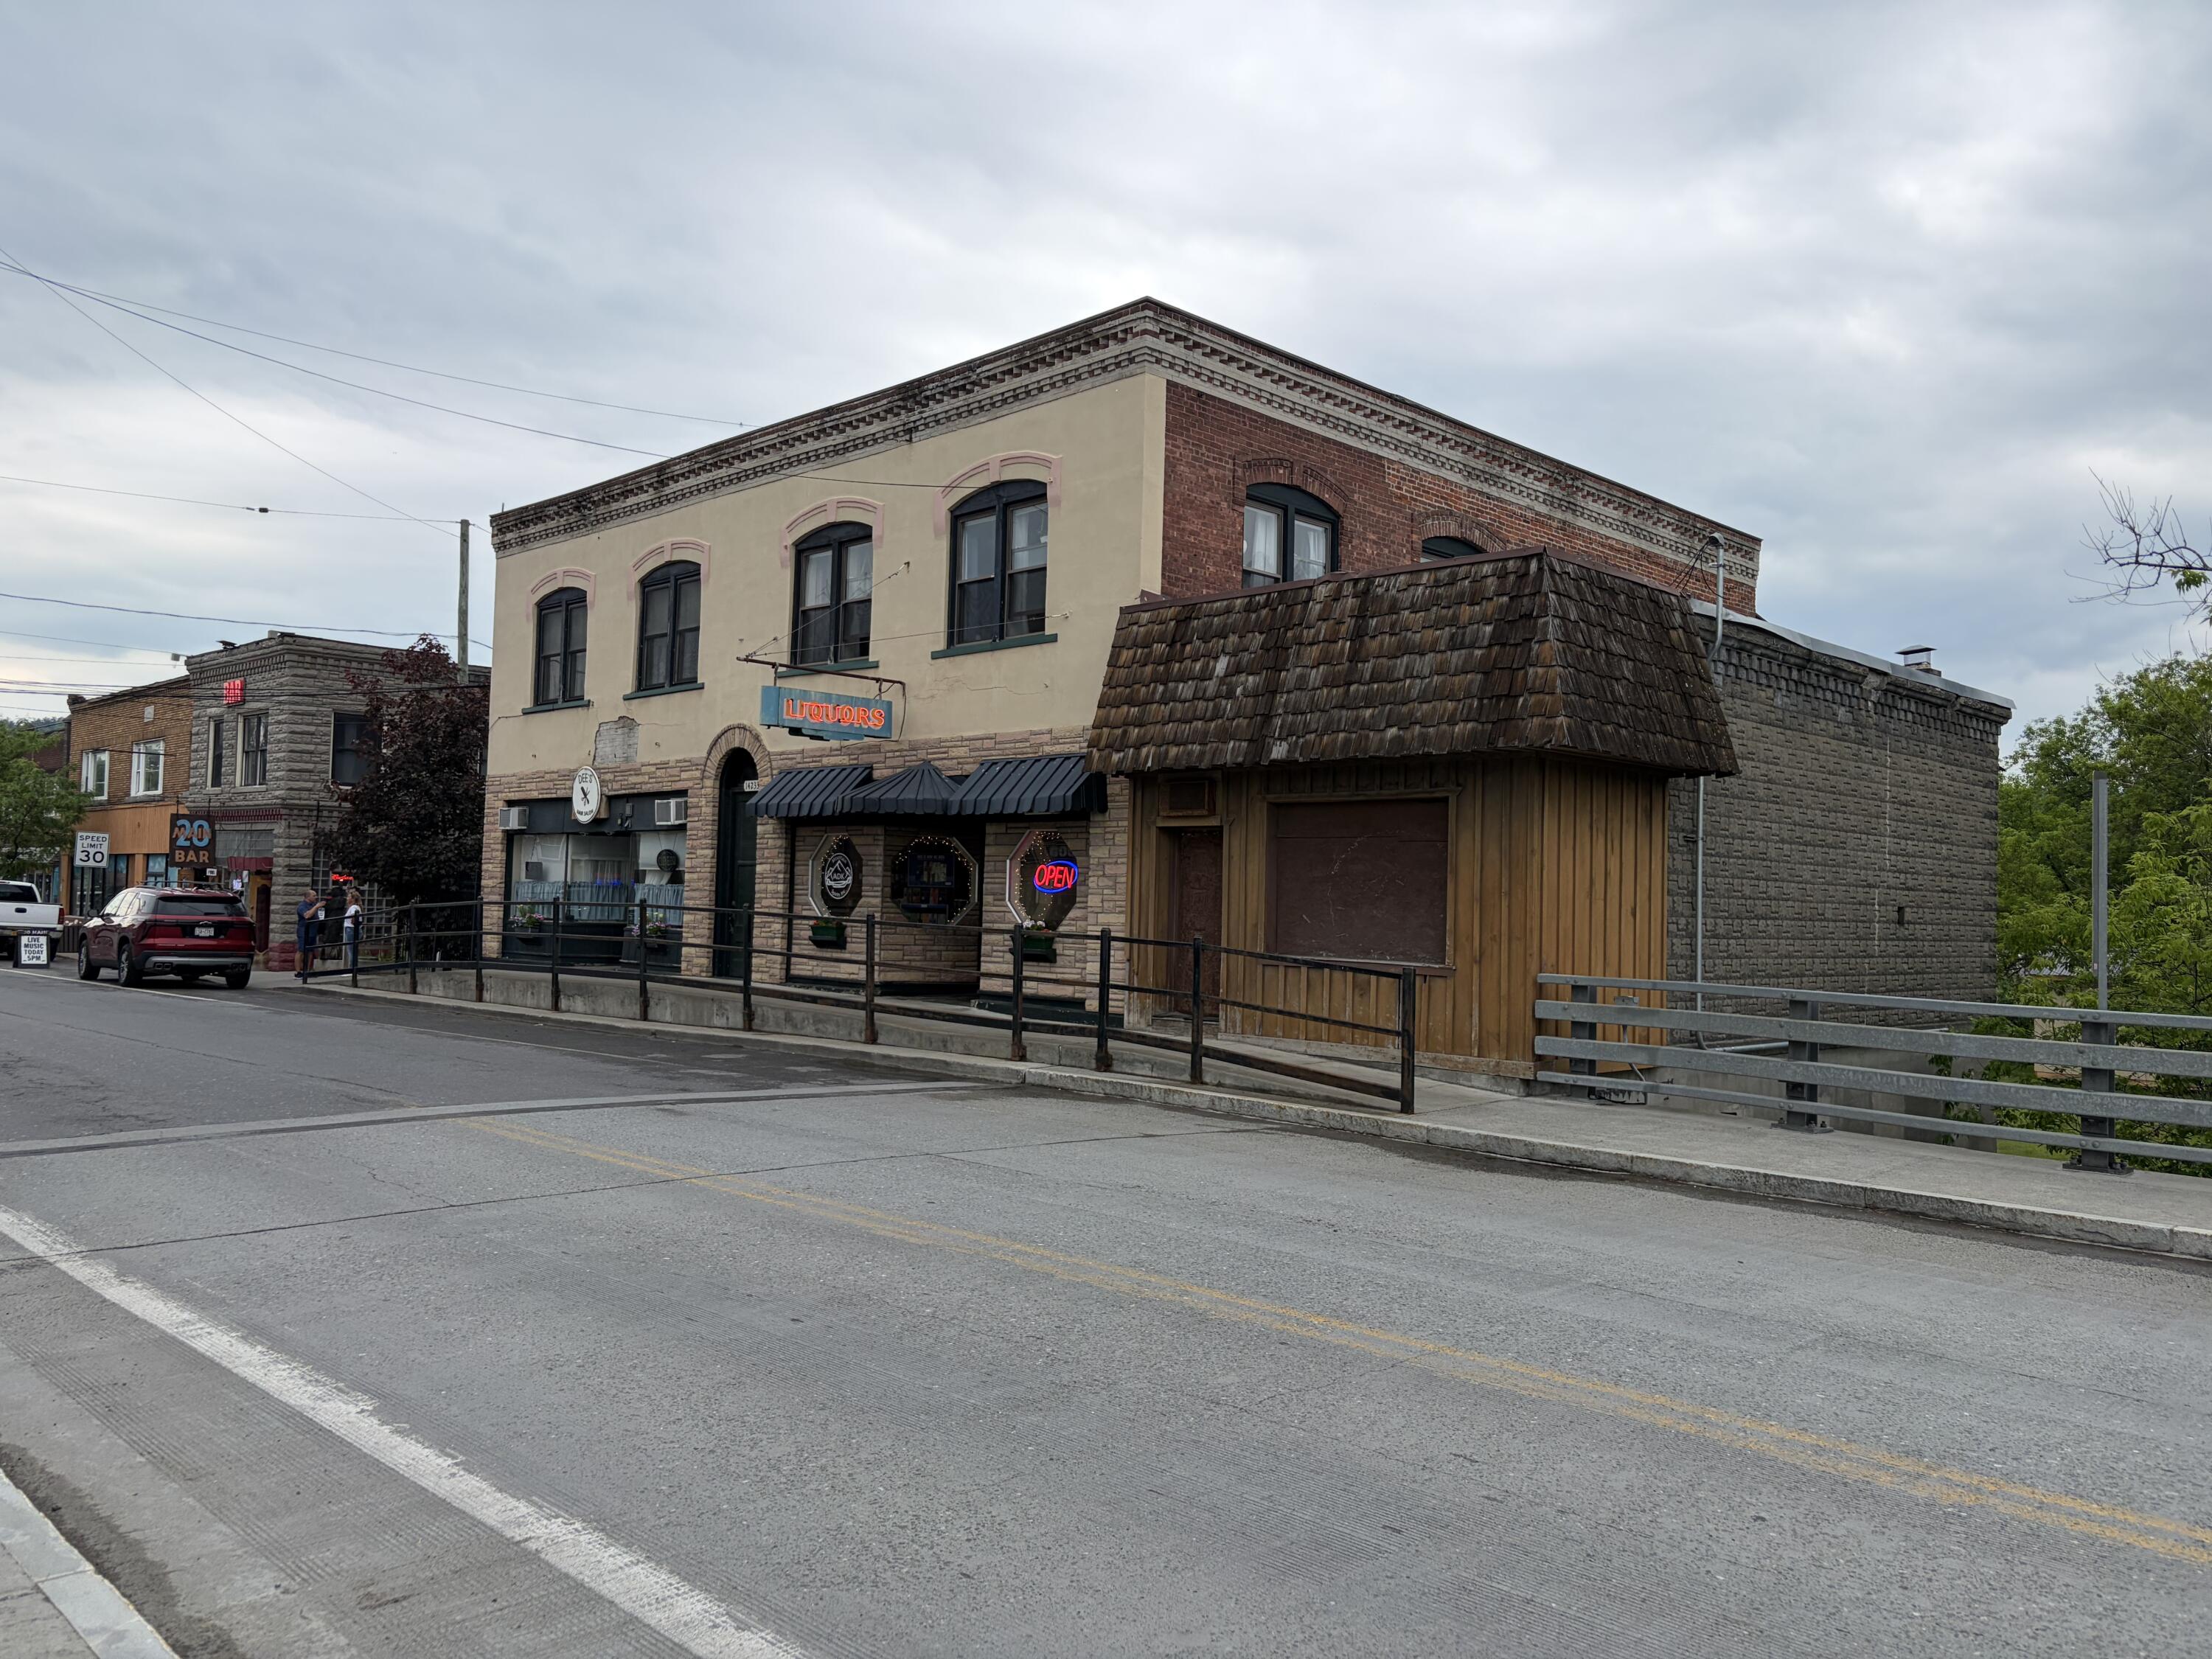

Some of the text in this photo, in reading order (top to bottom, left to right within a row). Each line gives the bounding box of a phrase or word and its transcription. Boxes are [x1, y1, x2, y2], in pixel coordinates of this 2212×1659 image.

[223, 680, 241, 704] BAR
[784, 698, 885, 730] LIQUORS
[578, 773, 593, 784] DEE'S
[79, 835, 108, 843] SPEED
[172, 827, 212, 839] MAIN
[176, 819, 210, 847] 20
[79, 850, 105, 863] 30
[175, 850, 209, 863] BAR
[1034, 864, 1075, 889] OPEN
